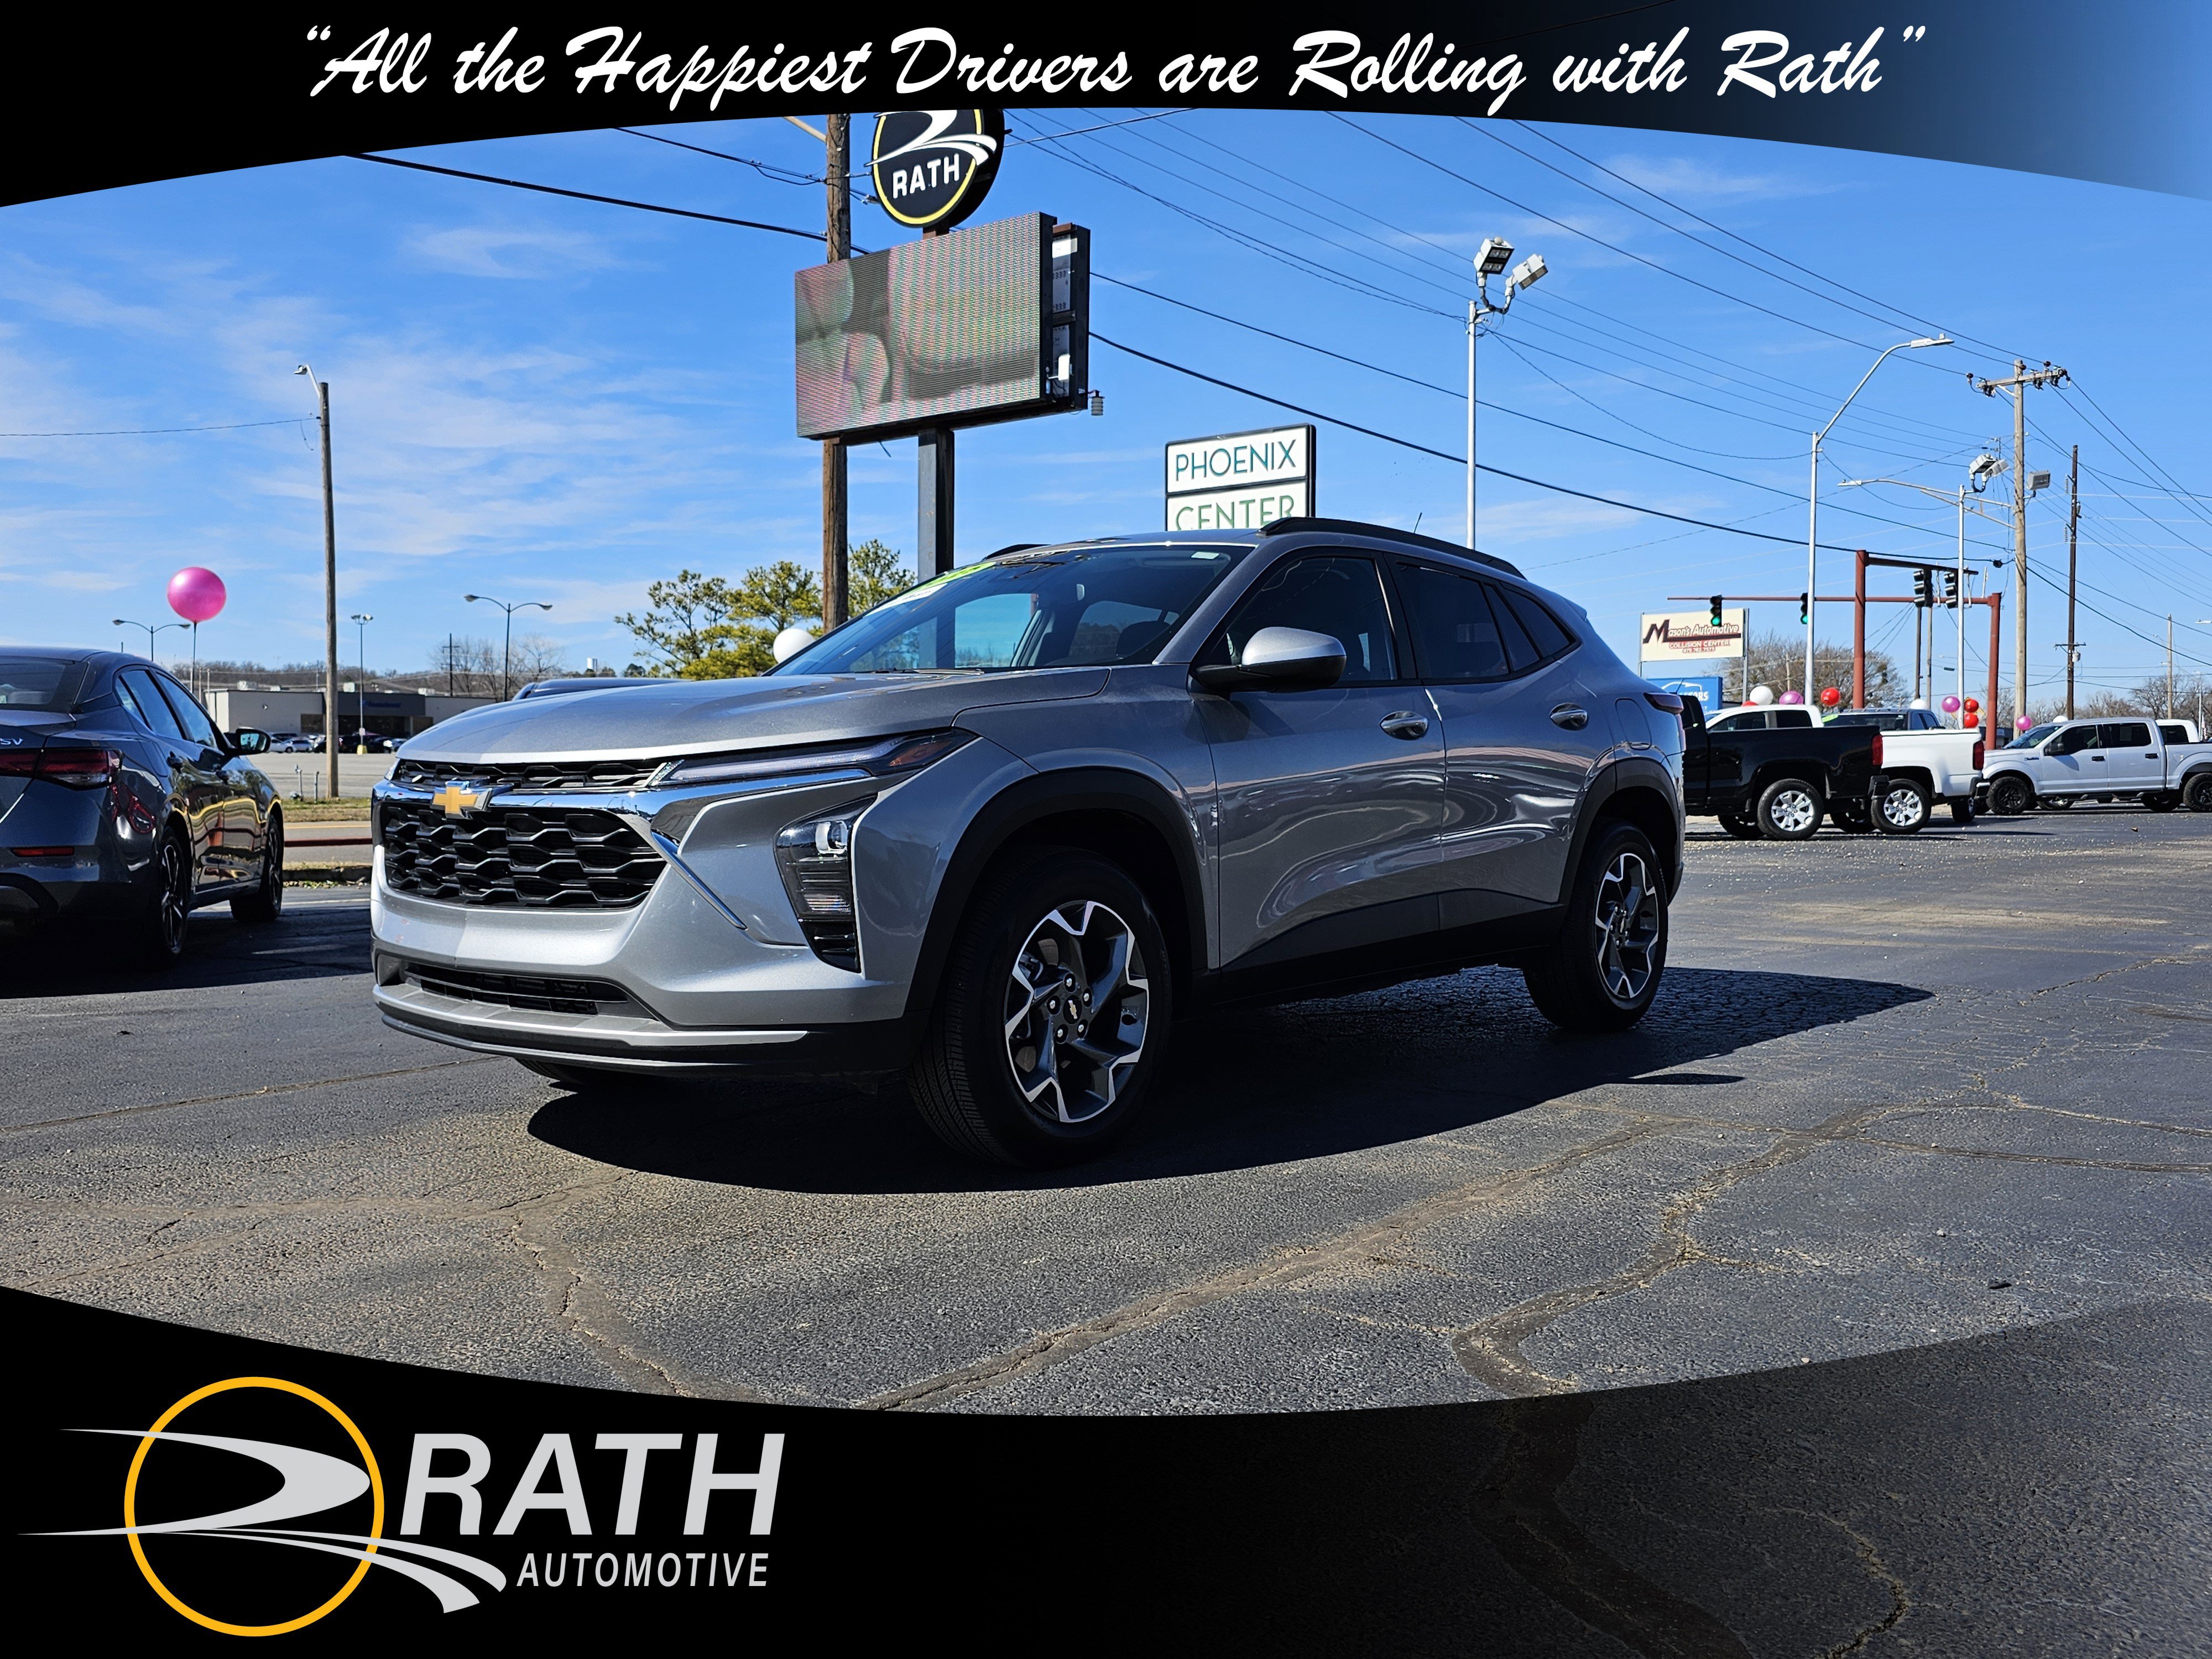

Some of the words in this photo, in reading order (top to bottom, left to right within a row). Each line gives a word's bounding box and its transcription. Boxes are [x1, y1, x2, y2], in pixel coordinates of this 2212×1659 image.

[893, 153, 959, 199] RATH
[1176, 439, 1297, 482] PHOENIX
[1176, 495, 1295, 530] CENTER
[1692, 623, 1740, 636] Automotive
[1703, 639, 1730, 648] CENTER
